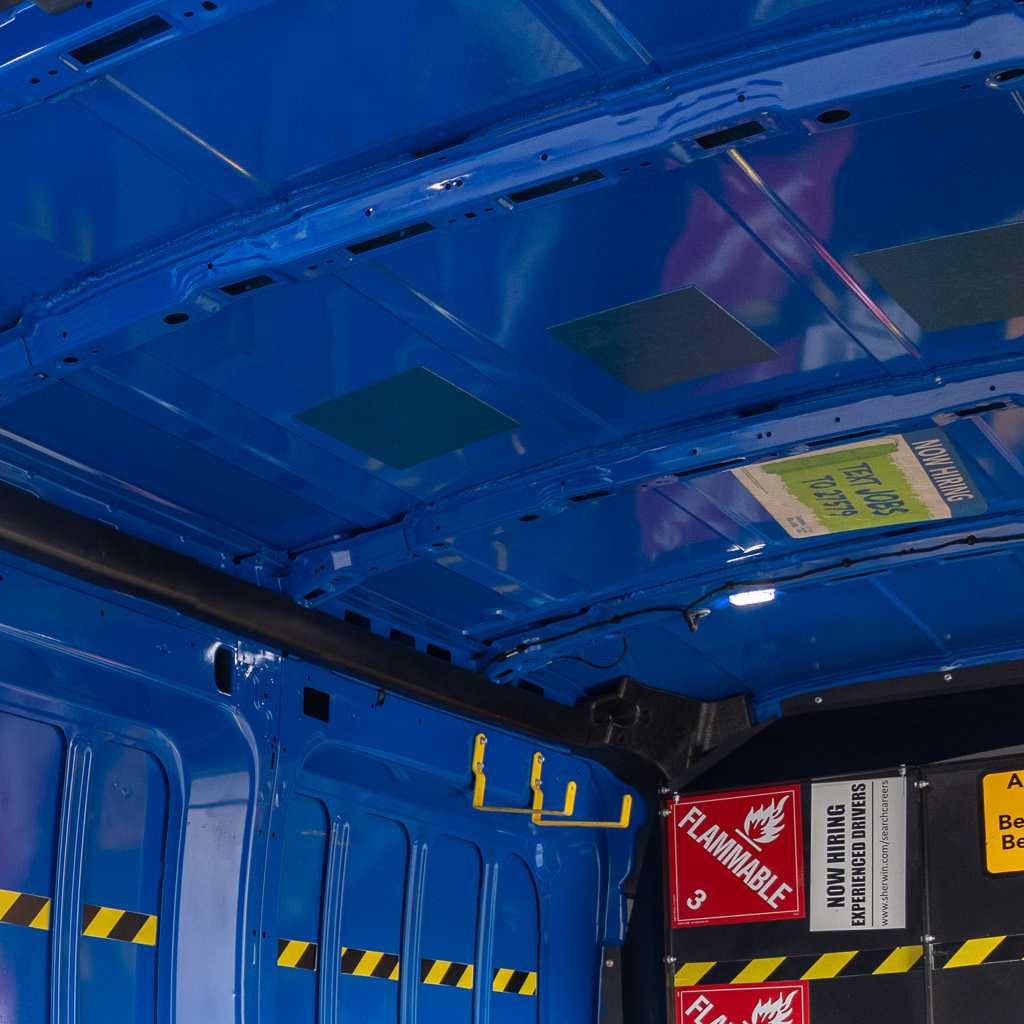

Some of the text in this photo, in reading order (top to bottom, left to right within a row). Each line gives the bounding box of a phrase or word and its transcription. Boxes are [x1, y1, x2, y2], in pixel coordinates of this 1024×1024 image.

[802, 474, 859, 516] TO 27579
[838, 462, 909, 516] TEXT JOBS
[911, 439, 974, 502] NOW HIRING
[678, 806, 793, 910] FLAMMABLE
[826, 804, 845, 908] NOW HIRING
[851, 783, 866, 927] EXPERIENCED DRIVERS
[879, 779, 890, 927] www.sherwin.com/searchcareers
[687, 889, 707, 910] 3
